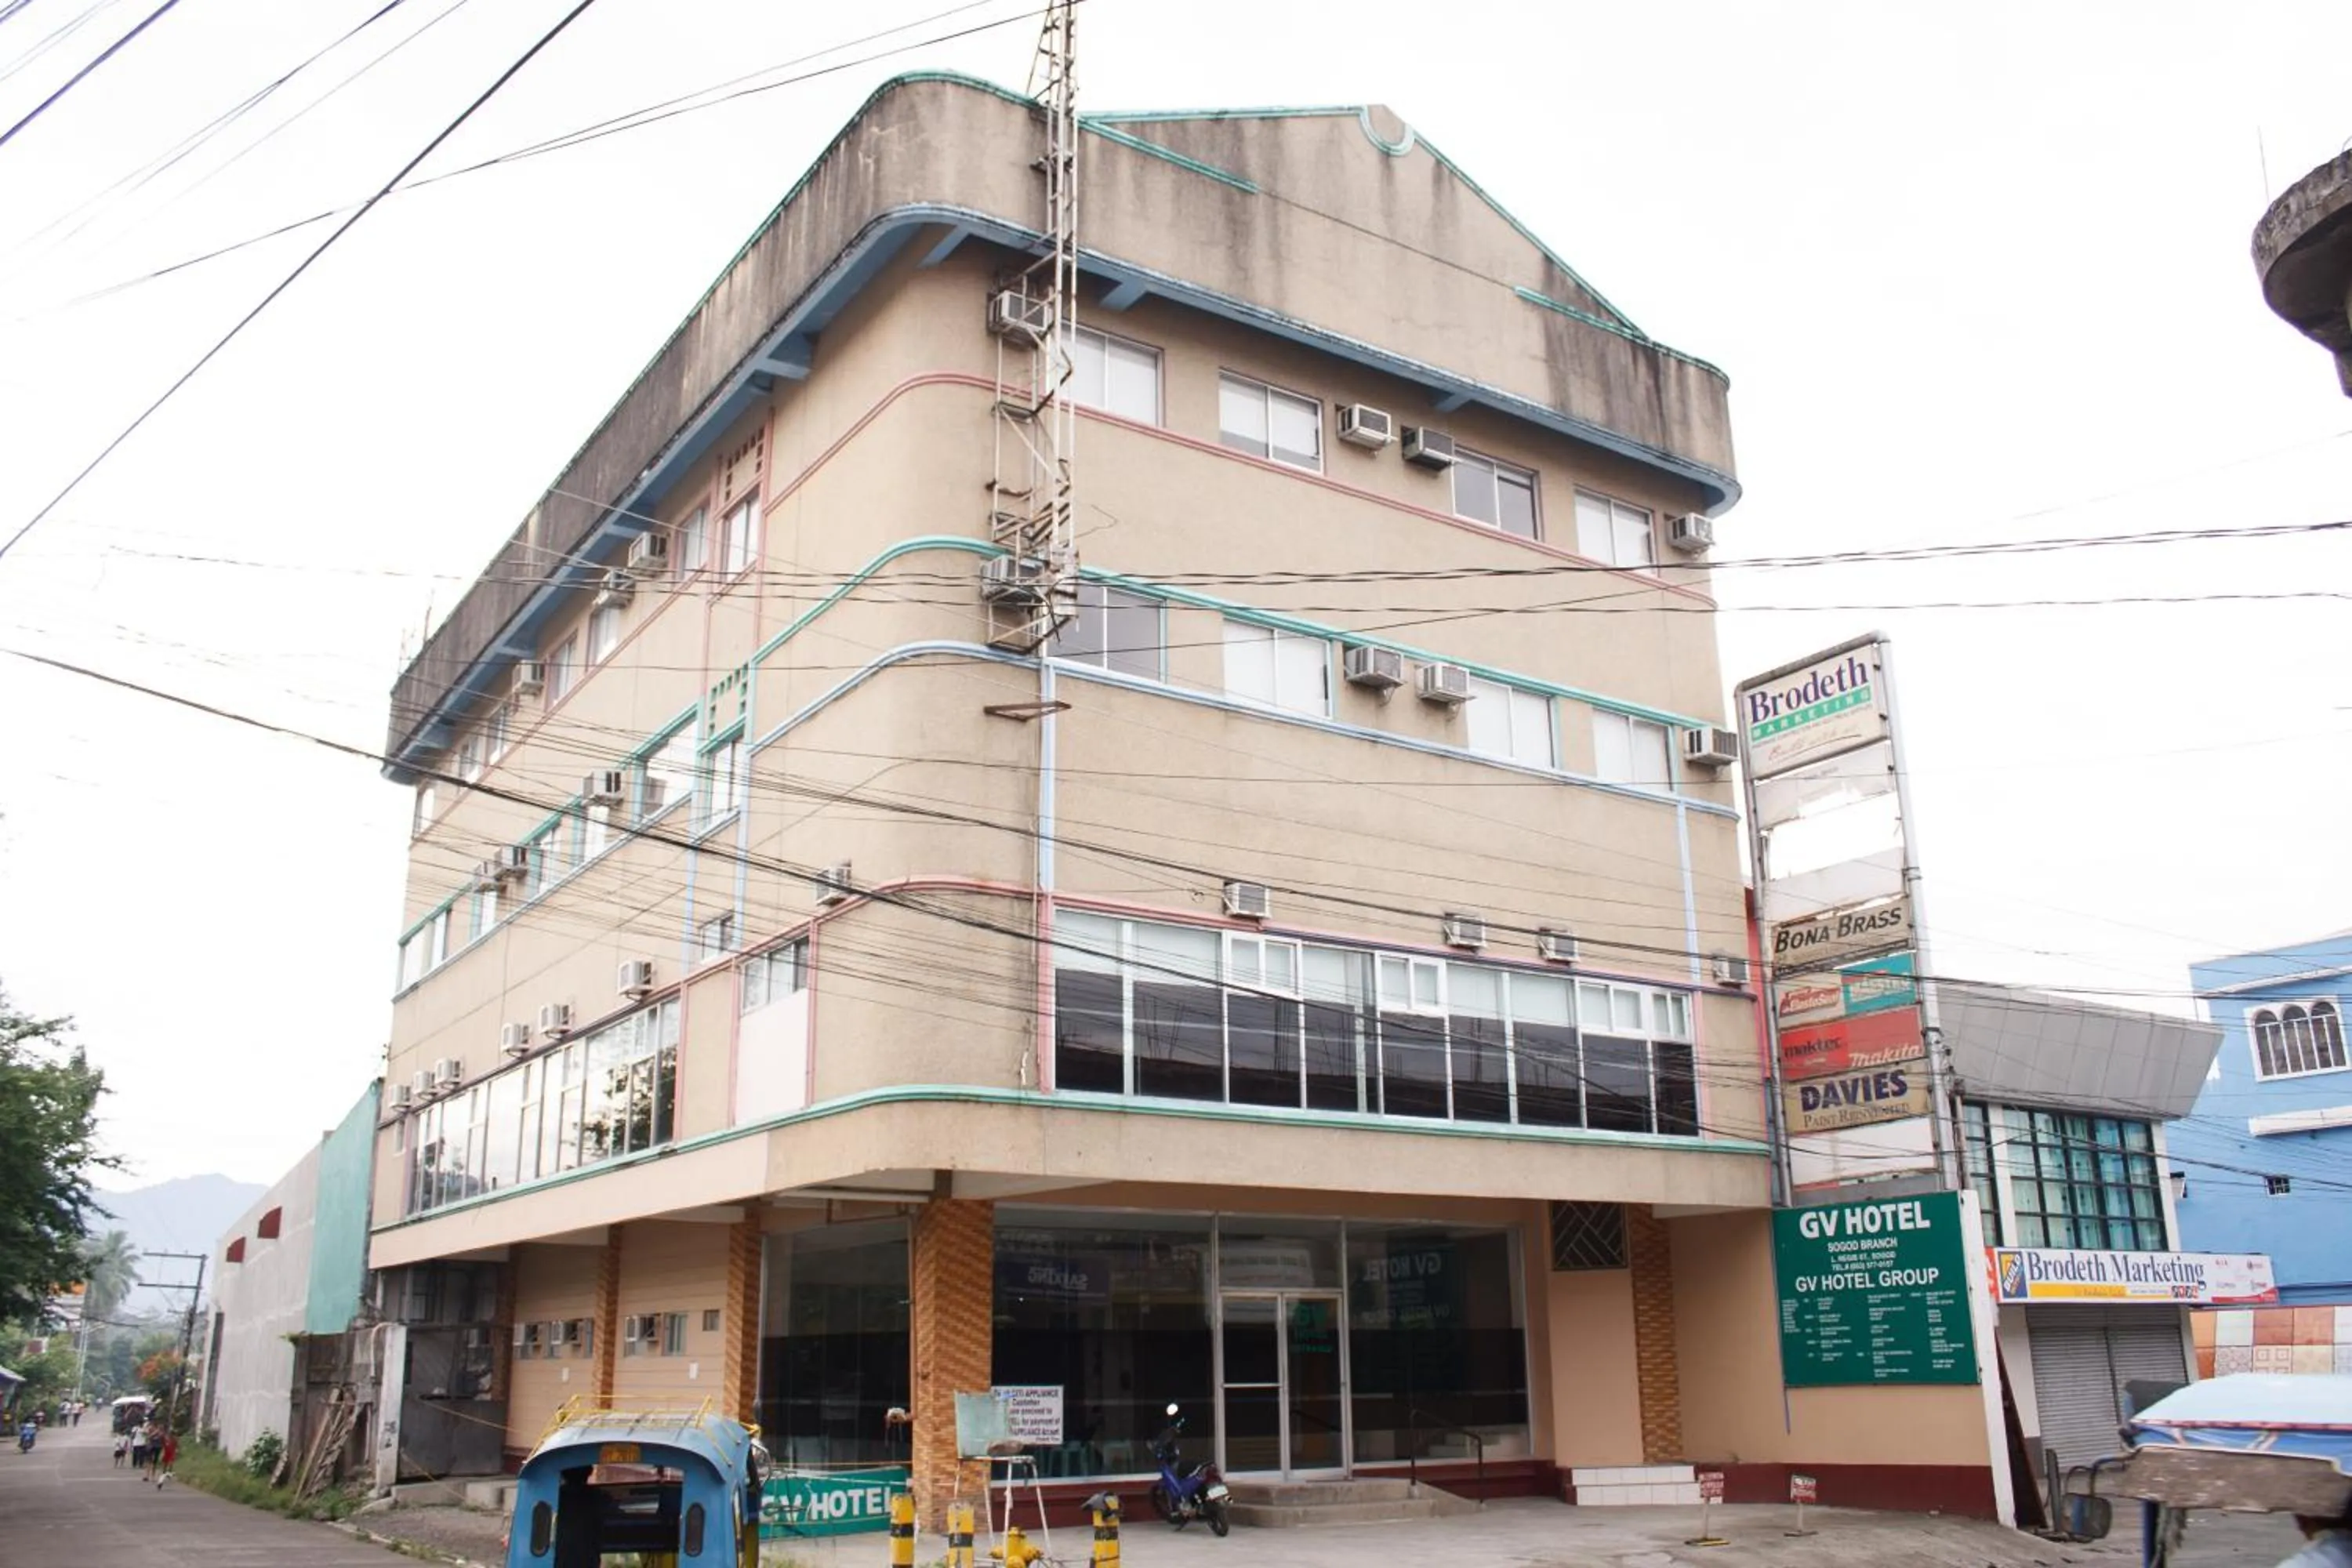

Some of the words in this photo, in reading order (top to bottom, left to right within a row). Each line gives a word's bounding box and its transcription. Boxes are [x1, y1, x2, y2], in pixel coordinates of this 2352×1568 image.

[1748, 657, 1869, 724] Brodeth
[1752, 691, 1871, 739] MARKETING
[1775, 926, 1830, 953] BONA
[1837, 907, 1901, 938] BRASS
[1848, 1043, 1920, 1067] makita
[1800, 1069, 1907, 1112] DAVIES
[1799, 1210, 1838, 1239] GV
[1844, 1200, 1931, 1236] HOTEL
[1828, 1240, 1859, 1253] SOGOD
[1860, 1236, 1898, 1250] BRANCH
[1795, 1276, 1817, 1292] GV
[1820, 1272, 1875, 1291] HOTEL
[1878, 1267, 1940, 1287] GROUP
[2027, 1250, 2107, 1282] Brodeth
[2110, 1253, 2207, 1291] Marketing
[760, 1494, 803, 1523] GV
[811, 1486, 891, 1520] HOTEL
